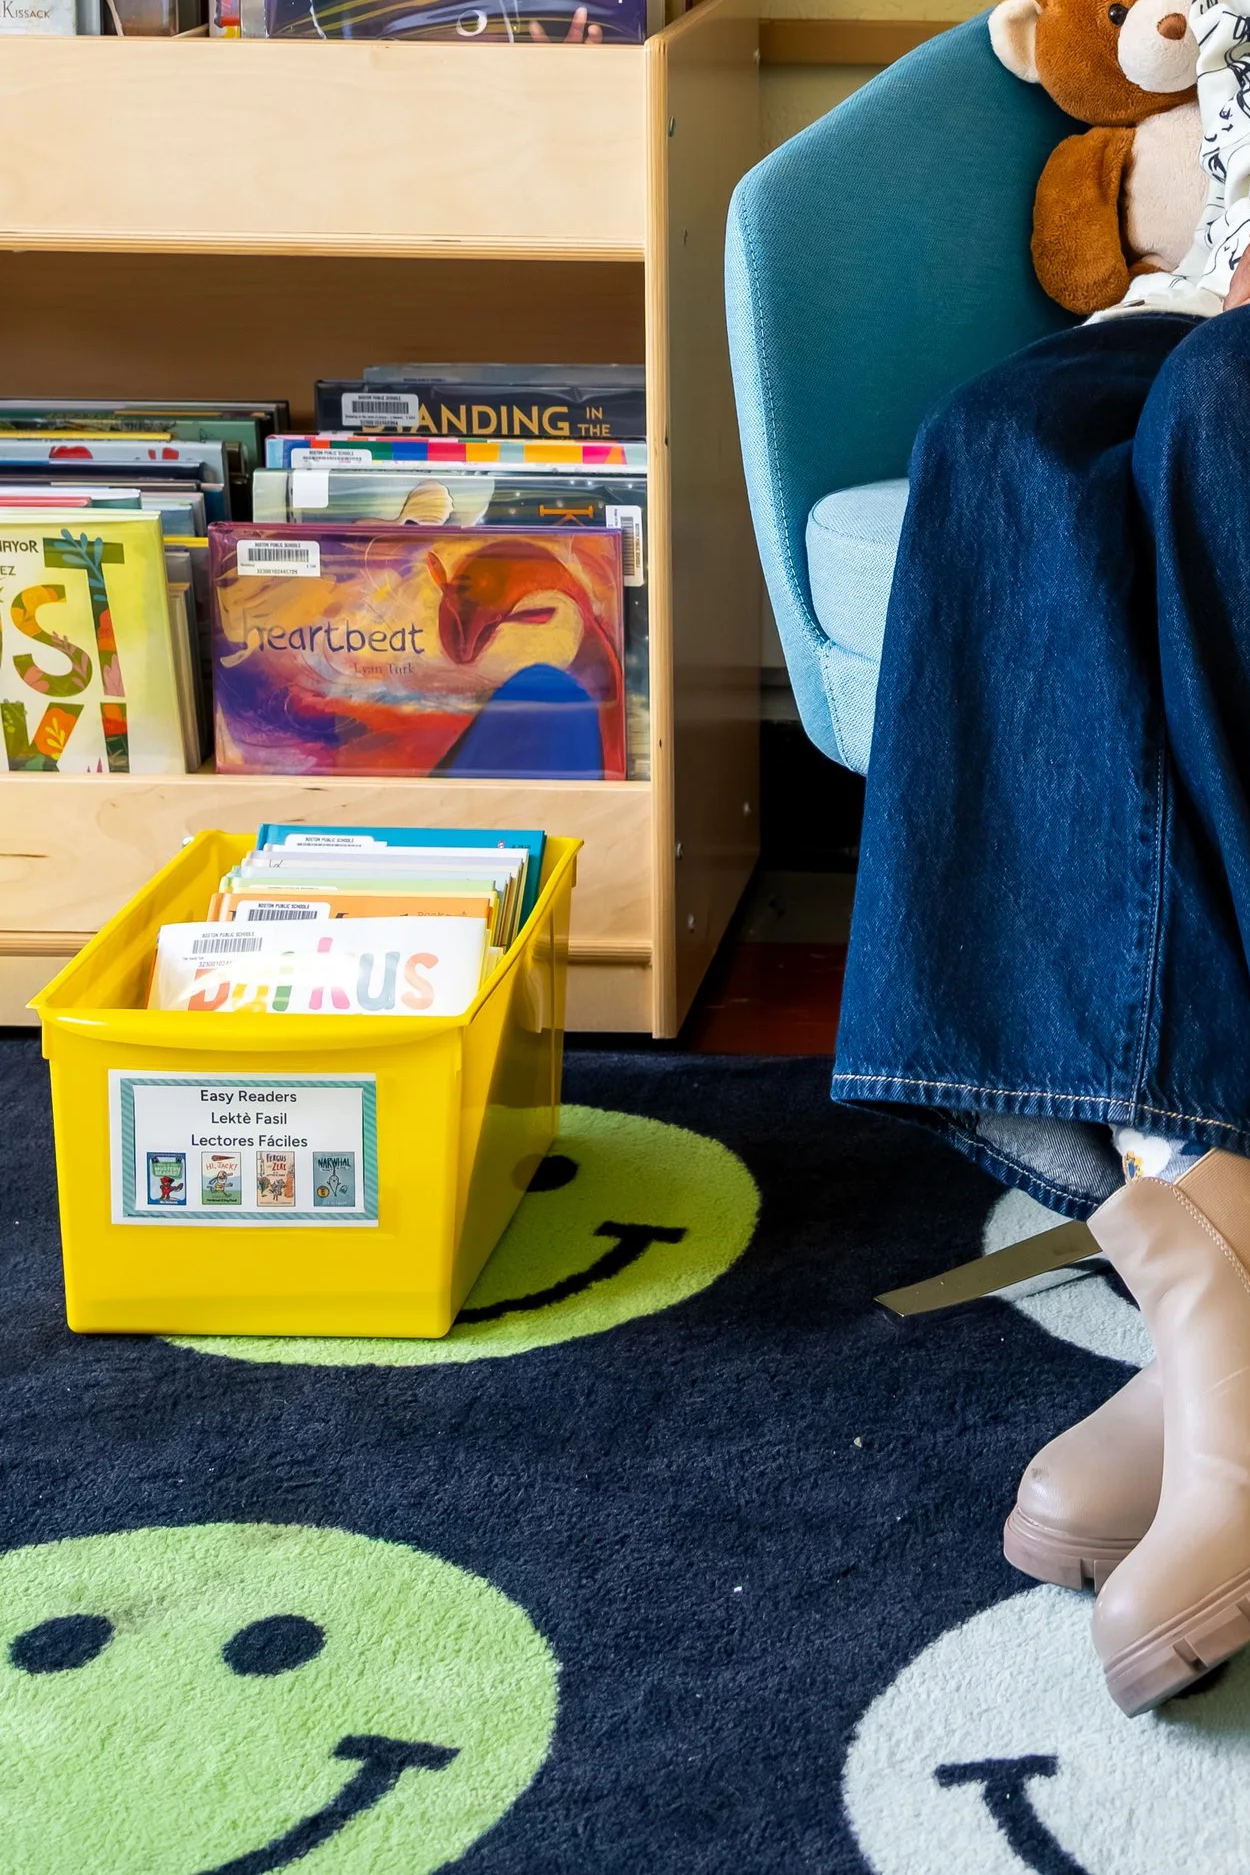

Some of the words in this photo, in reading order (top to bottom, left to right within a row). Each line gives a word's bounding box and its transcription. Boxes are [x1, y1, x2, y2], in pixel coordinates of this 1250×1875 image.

[585, 406, 603, 419] IN
[363, 404, 571, 437] ANDING
[577, 424, 611, 438] THE
[248, 619, 425, 655] heartbeat
[200, 1090, 235, 1106] Easy
[238, 1090, 297, 1103] Readers
[211, 1112, 251, 1125] Lektè
[256, 1112, 287, 1125] Fasil
[191, 1134, 255, 1148] Lectores
[258, 1134, 308, 1148] Fáciles
